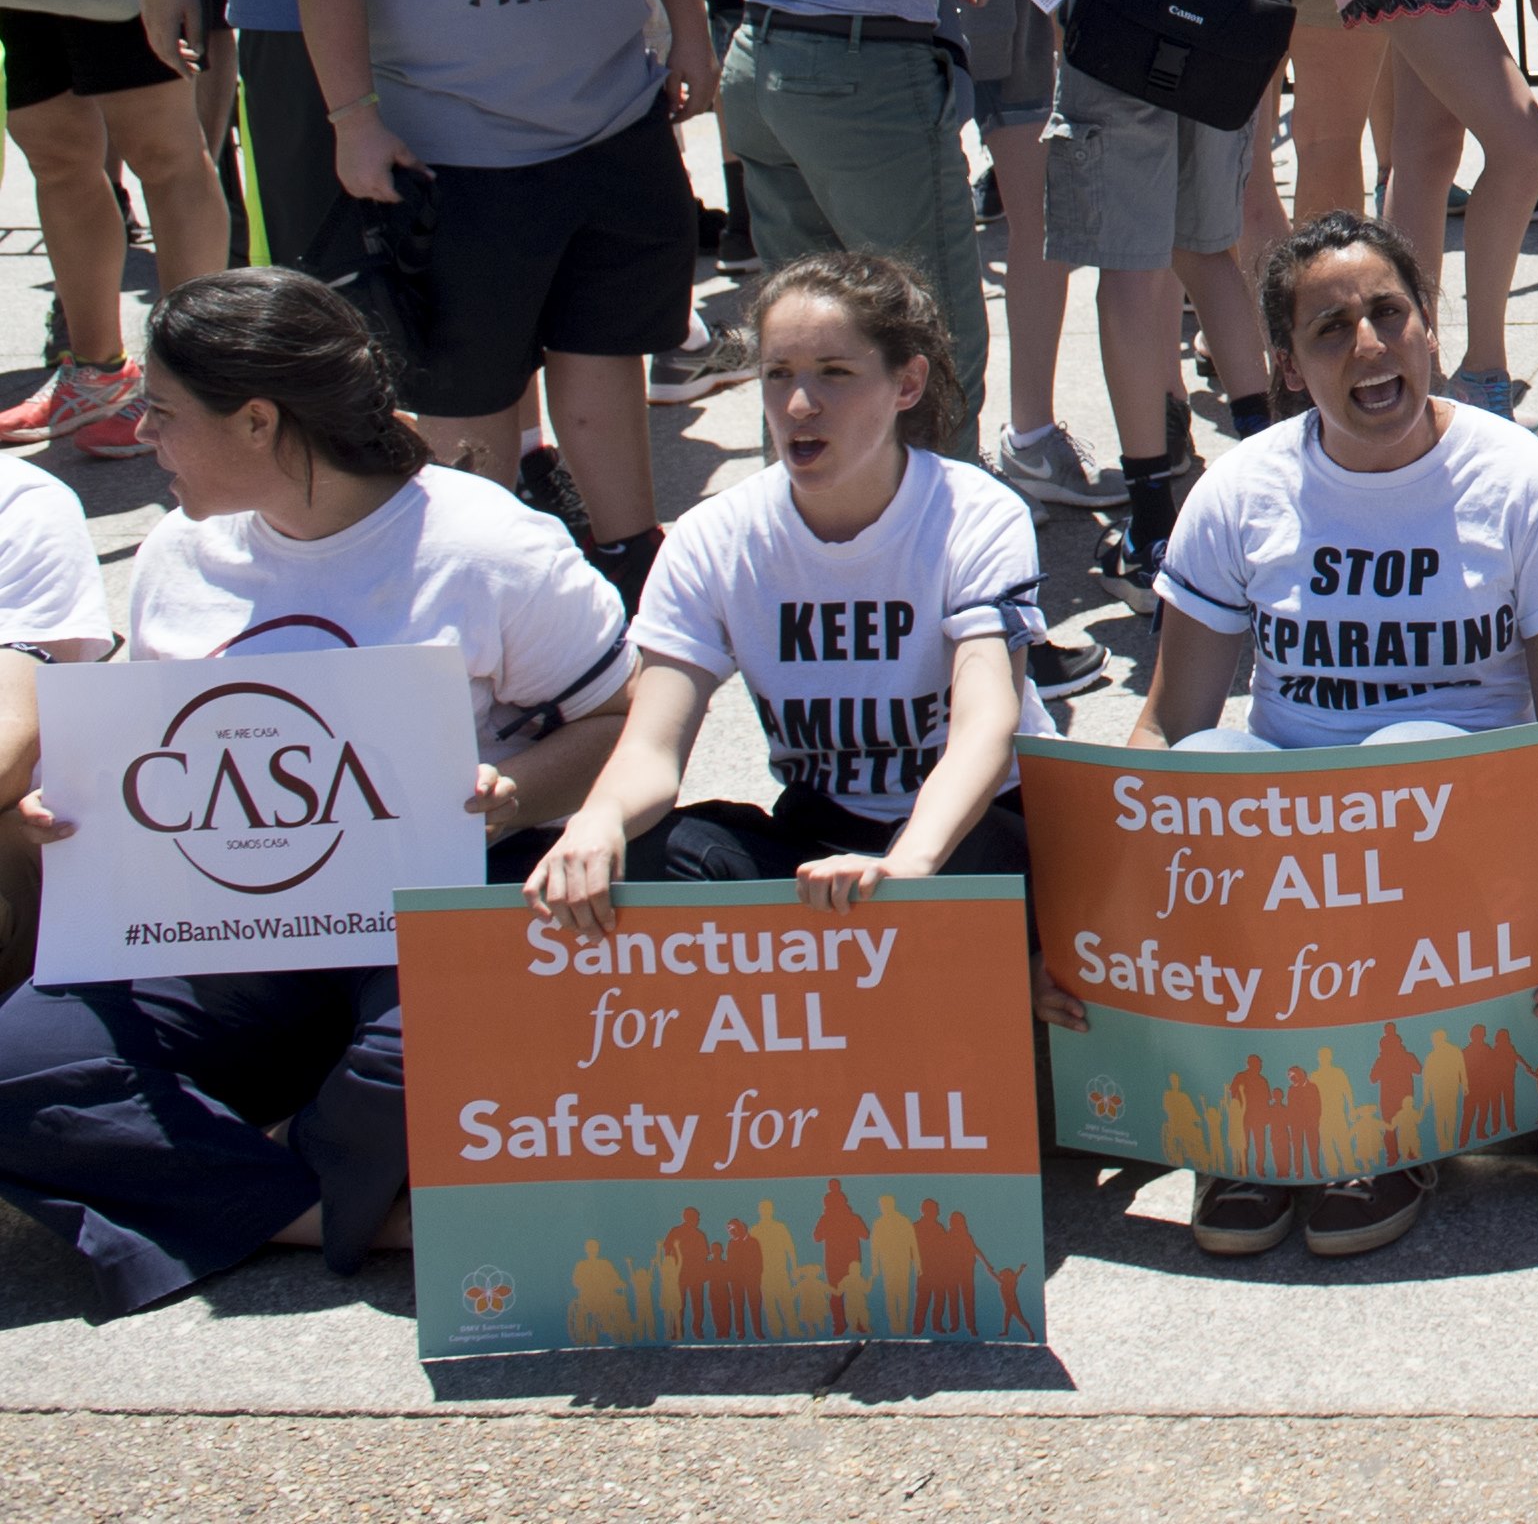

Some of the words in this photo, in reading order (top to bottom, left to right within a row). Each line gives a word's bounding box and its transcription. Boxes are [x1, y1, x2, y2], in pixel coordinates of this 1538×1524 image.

[1168, 4, 1203, 25] Canon
[1310, 546, 1439, 598] STOP
[779, 601, 915, 662] KEEP
[254, 727, 279, 738] CASA
[122, 741, 400, 832] CASA
[1112, 775, 1454, 843] Sanctuary
[226, 839, 260, 850] SOMOS
[263, 837, 289, 849] CASA
[1156, 847, 1244, 919] for
[1263, 849, 1403, 912] ALL
[526, 913, 897, 988] Sanctuary
[1074, 930, 1262, 1023] Safety
[1275, 943, 1375, 1021] for
[1397, 922, 1532, 995] ALL
[577, 987, 678, 1068] for
[700, 992, 847, 1053] ALL
[458, 1093, 699, 1173] Safety
[713, 1089, 819, 1170] for
[842, 1091, 988, 1151] ALL
